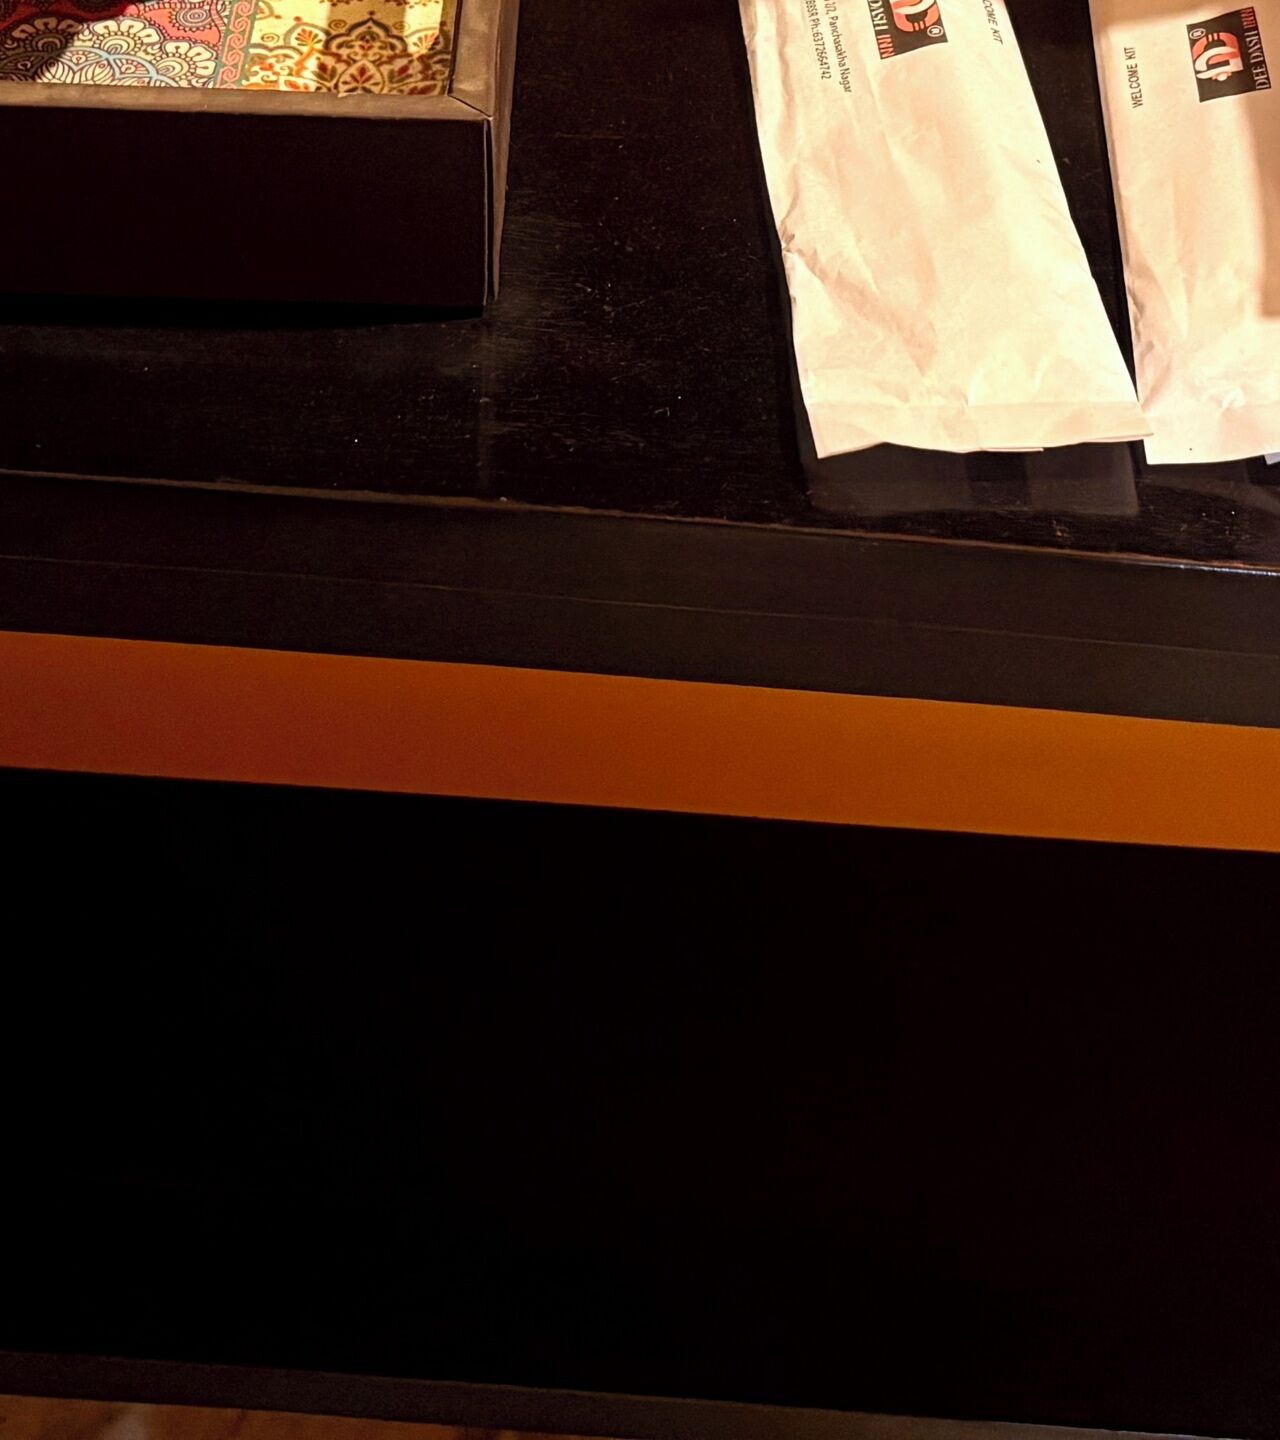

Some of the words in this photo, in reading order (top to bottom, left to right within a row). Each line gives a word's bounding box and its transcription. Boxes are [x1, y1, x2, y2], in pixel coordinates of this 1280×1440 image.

[876, 34, 895, 59] INN
[991, 28, 1004, 46] KIT
[1244, 31, 1265, 64] DASH
[828, 16, 847, 68] Panchasakha
[839, 67, 852, 93] Nagar
[1123, 47, 1137, 61] KIT
[1127, 62, 1144, 109] WELCOME
[1251, 66, 1271, 90] DEE
